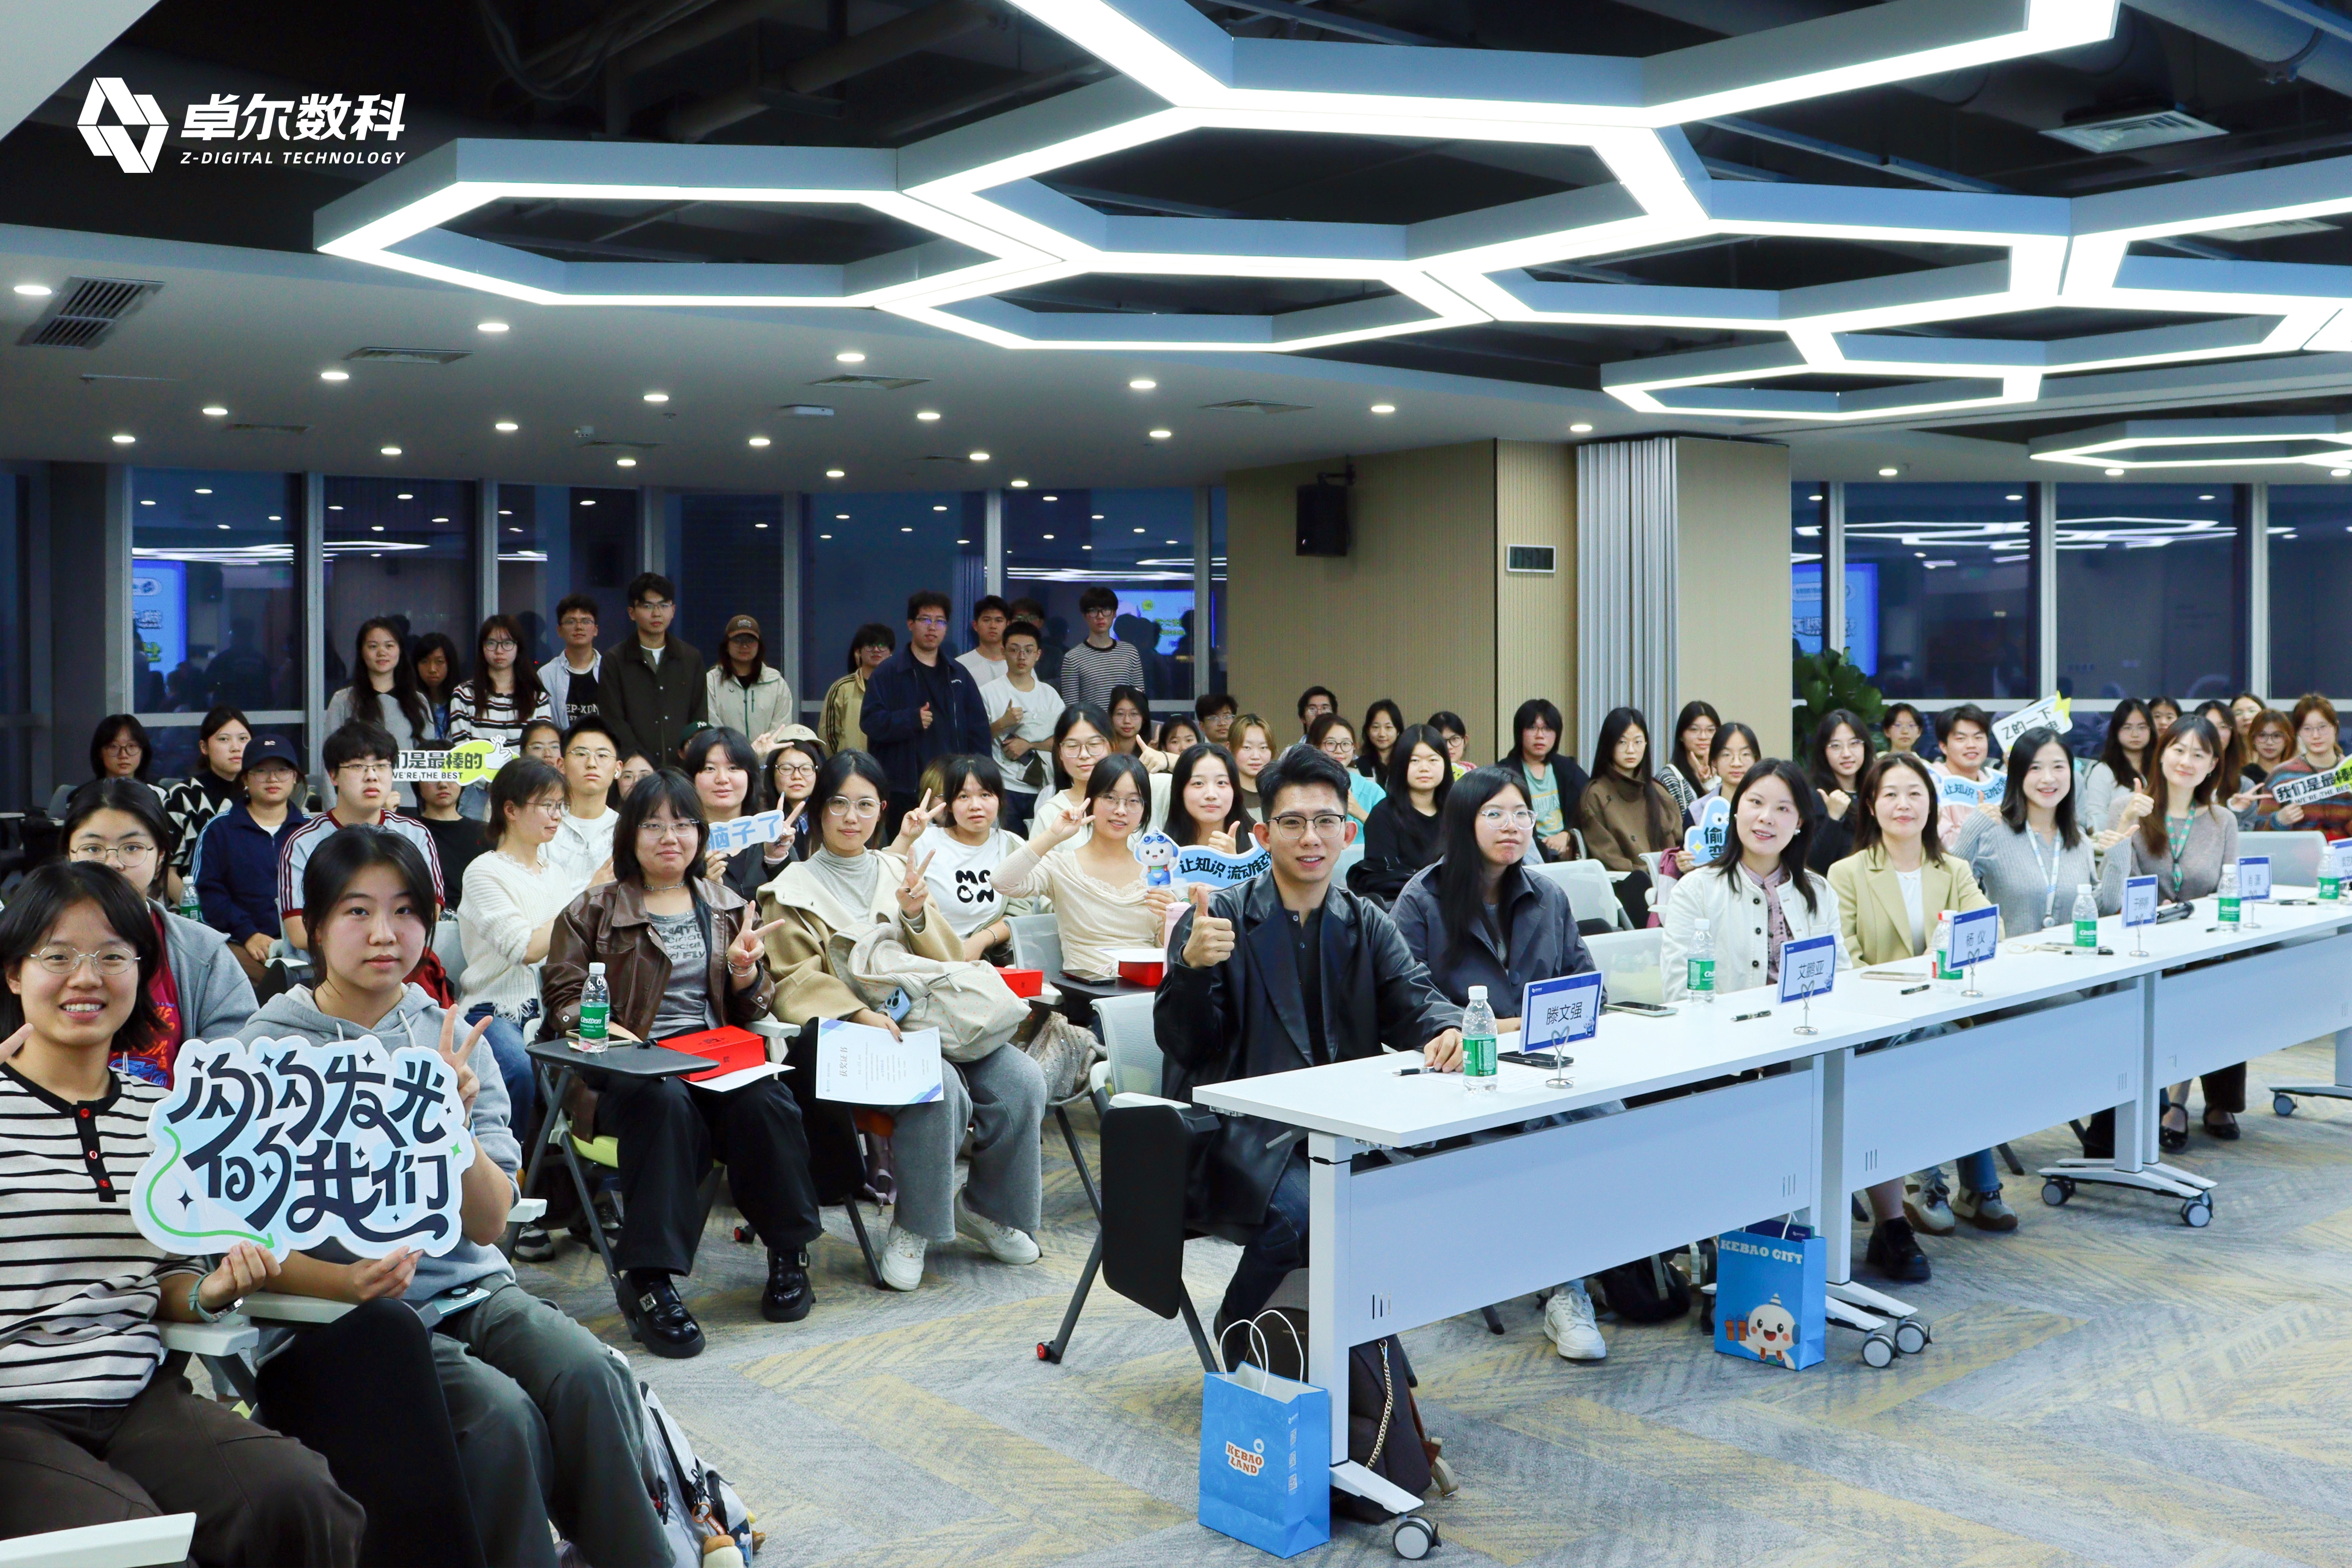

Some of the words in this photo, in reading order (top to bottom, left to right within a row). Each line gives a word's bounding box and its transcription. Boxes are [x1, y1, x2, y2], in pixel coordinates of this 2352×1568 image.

[2276, 766, 2352, 800] 我们是最棒
[2320, 788, 2335, 797] THE
[2336, 784, 2351, 793] BES
[1704, 827, 1726, 844] 偷
[1546, 1001, 1583, 1025] 滕文强
[1720, 1239, 1769, 1258] KEBAO
[1227, 1443, 1263, 1466] KEBAO
[1230, 1457, 1258, 1475] LAND
